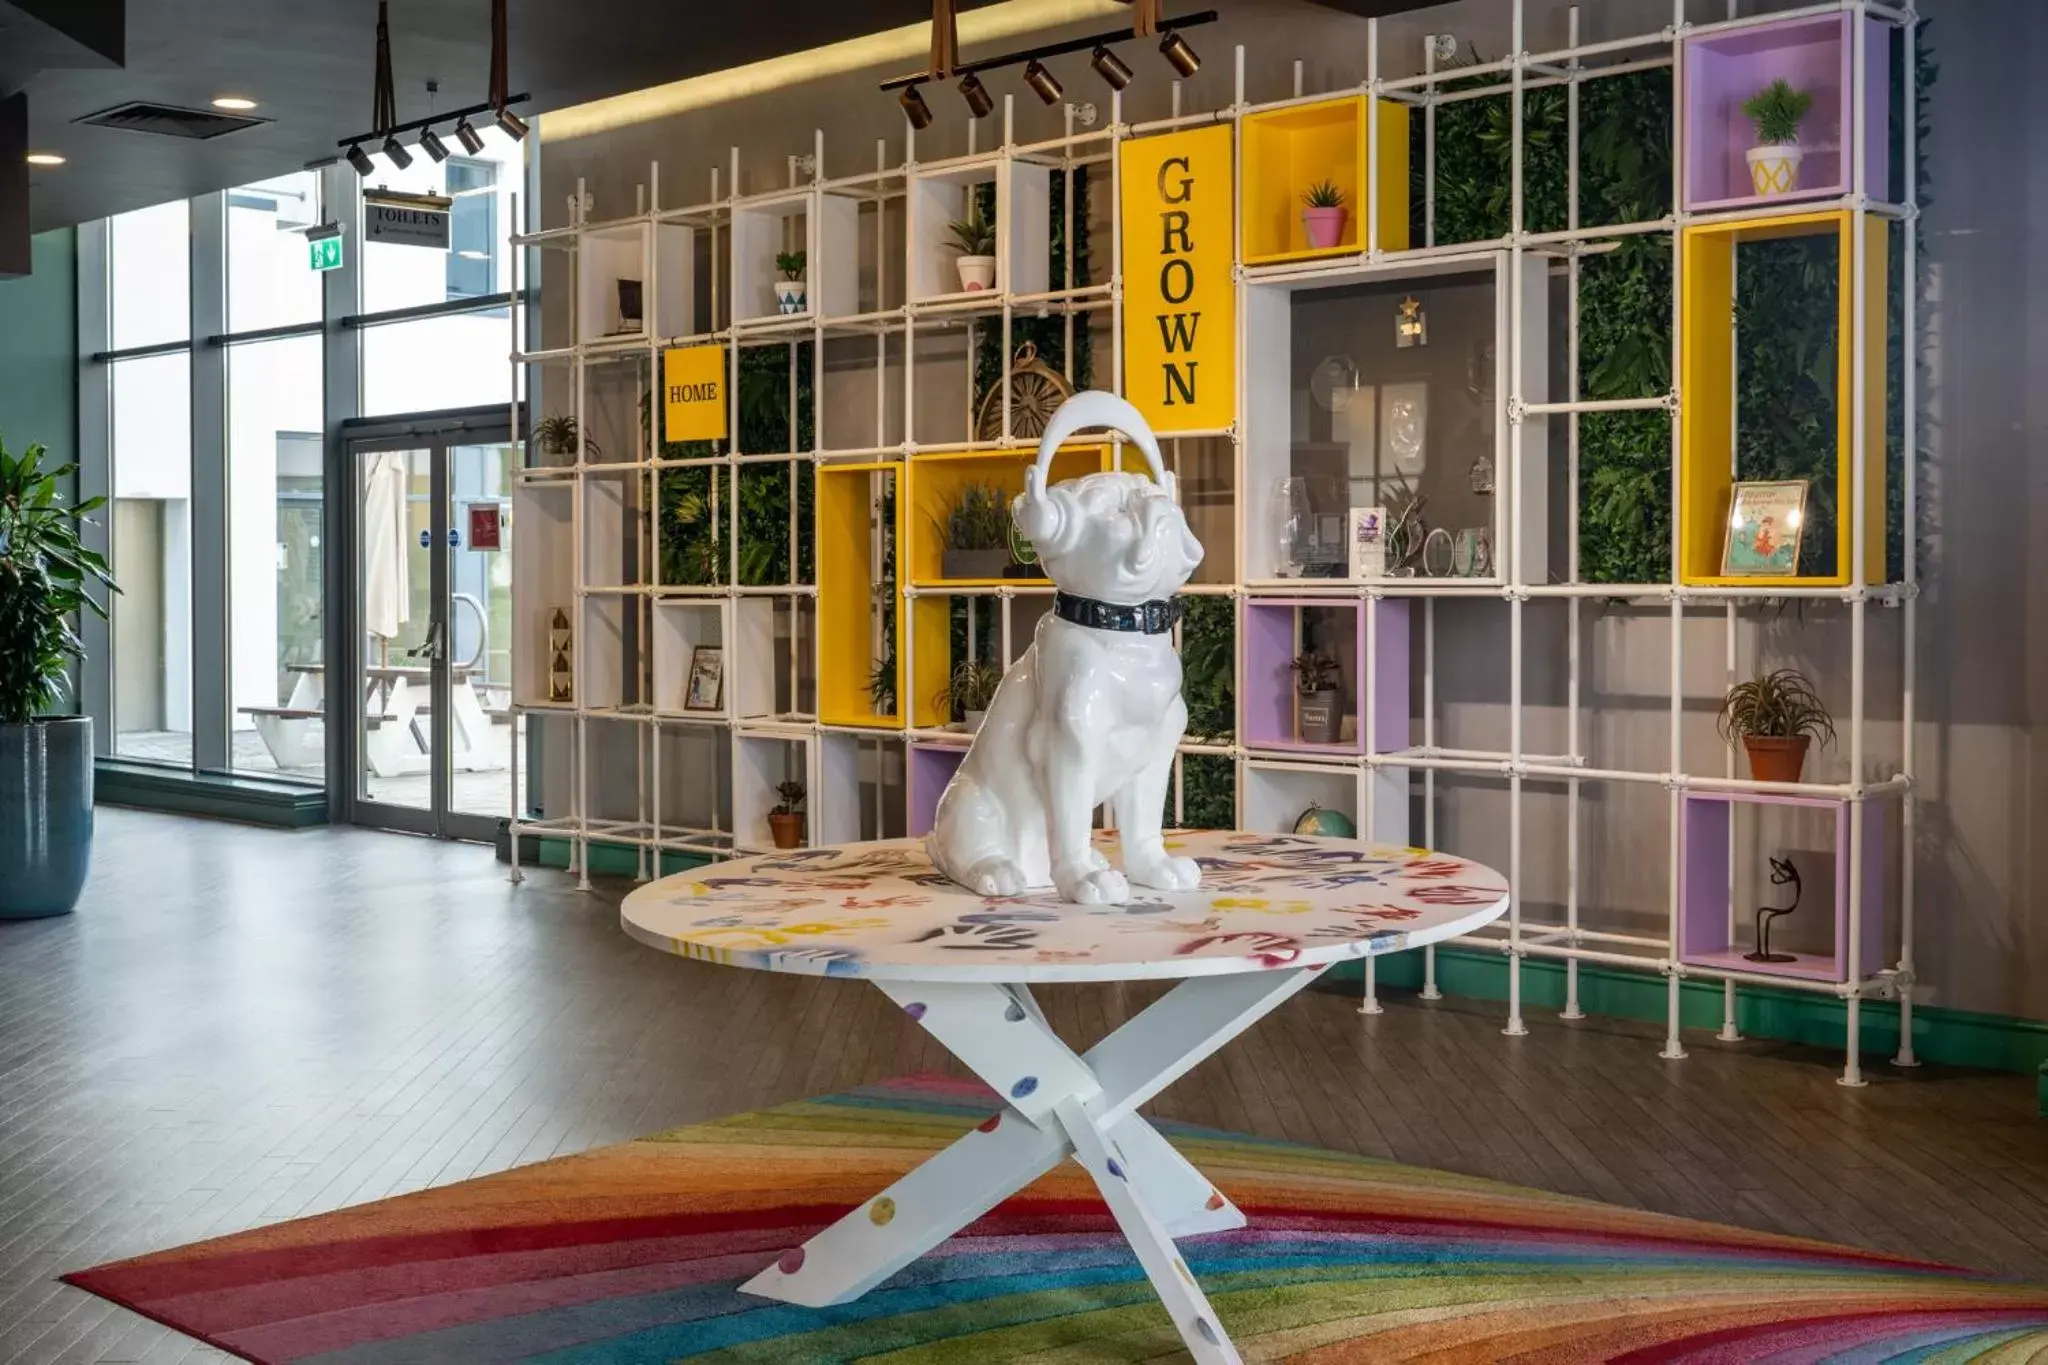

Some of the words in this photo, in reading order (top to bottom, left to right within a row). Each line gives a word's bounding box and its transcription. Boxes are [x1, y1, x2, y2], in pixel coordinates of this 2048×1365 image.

[374, 206, 441, 226] TOILETS
[1157, 156, 1201, 406] GROWN
[669, 382, 718, 404] HOME
